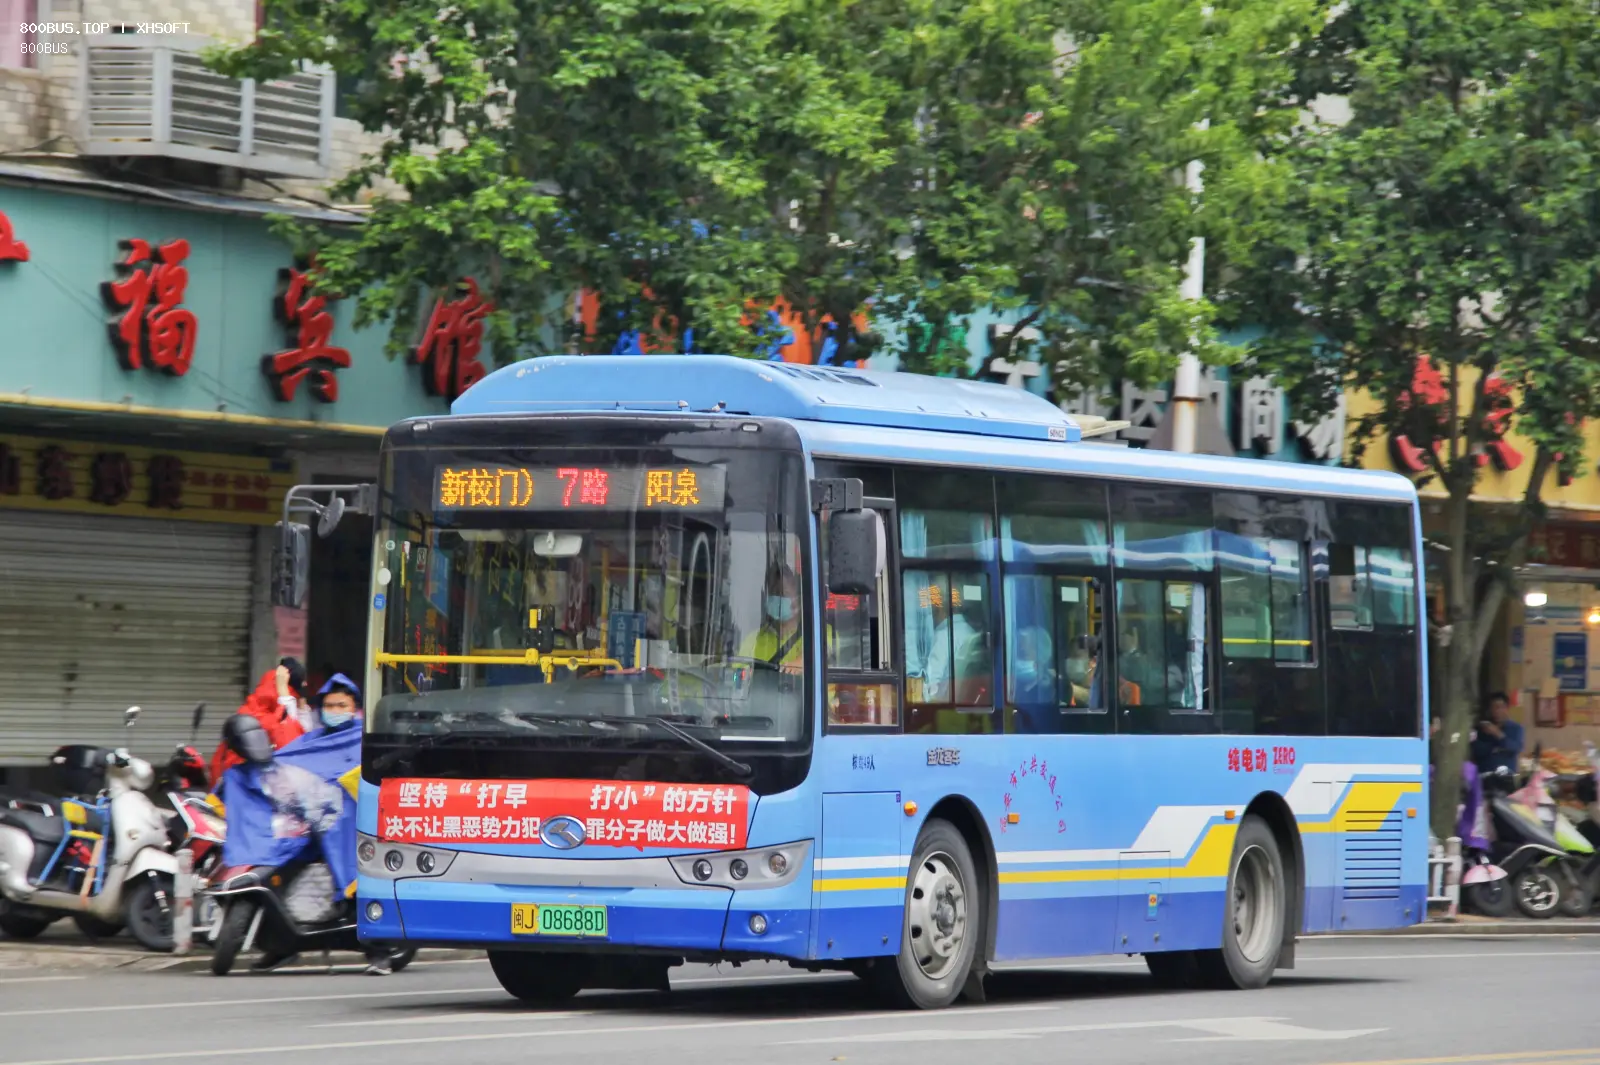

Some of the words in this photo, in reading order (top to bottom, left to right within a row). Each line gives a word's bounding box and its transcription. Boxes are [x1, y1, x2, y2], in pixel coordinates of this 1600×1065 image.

[557, 467, 608, 506] 7路
[646, 468, 700, 506] 阳泉
[926, 747, 961, 766] 金龙客车
[1228, 747, 1268, 772] 纯电动
[1273, 746, 1295, 765] ZERO
[384, 816, 541, 839] 决不让黑恶势力犯
[513, 908, 534, 929] 闽J
[543, 909, 604, 931] 08688D
